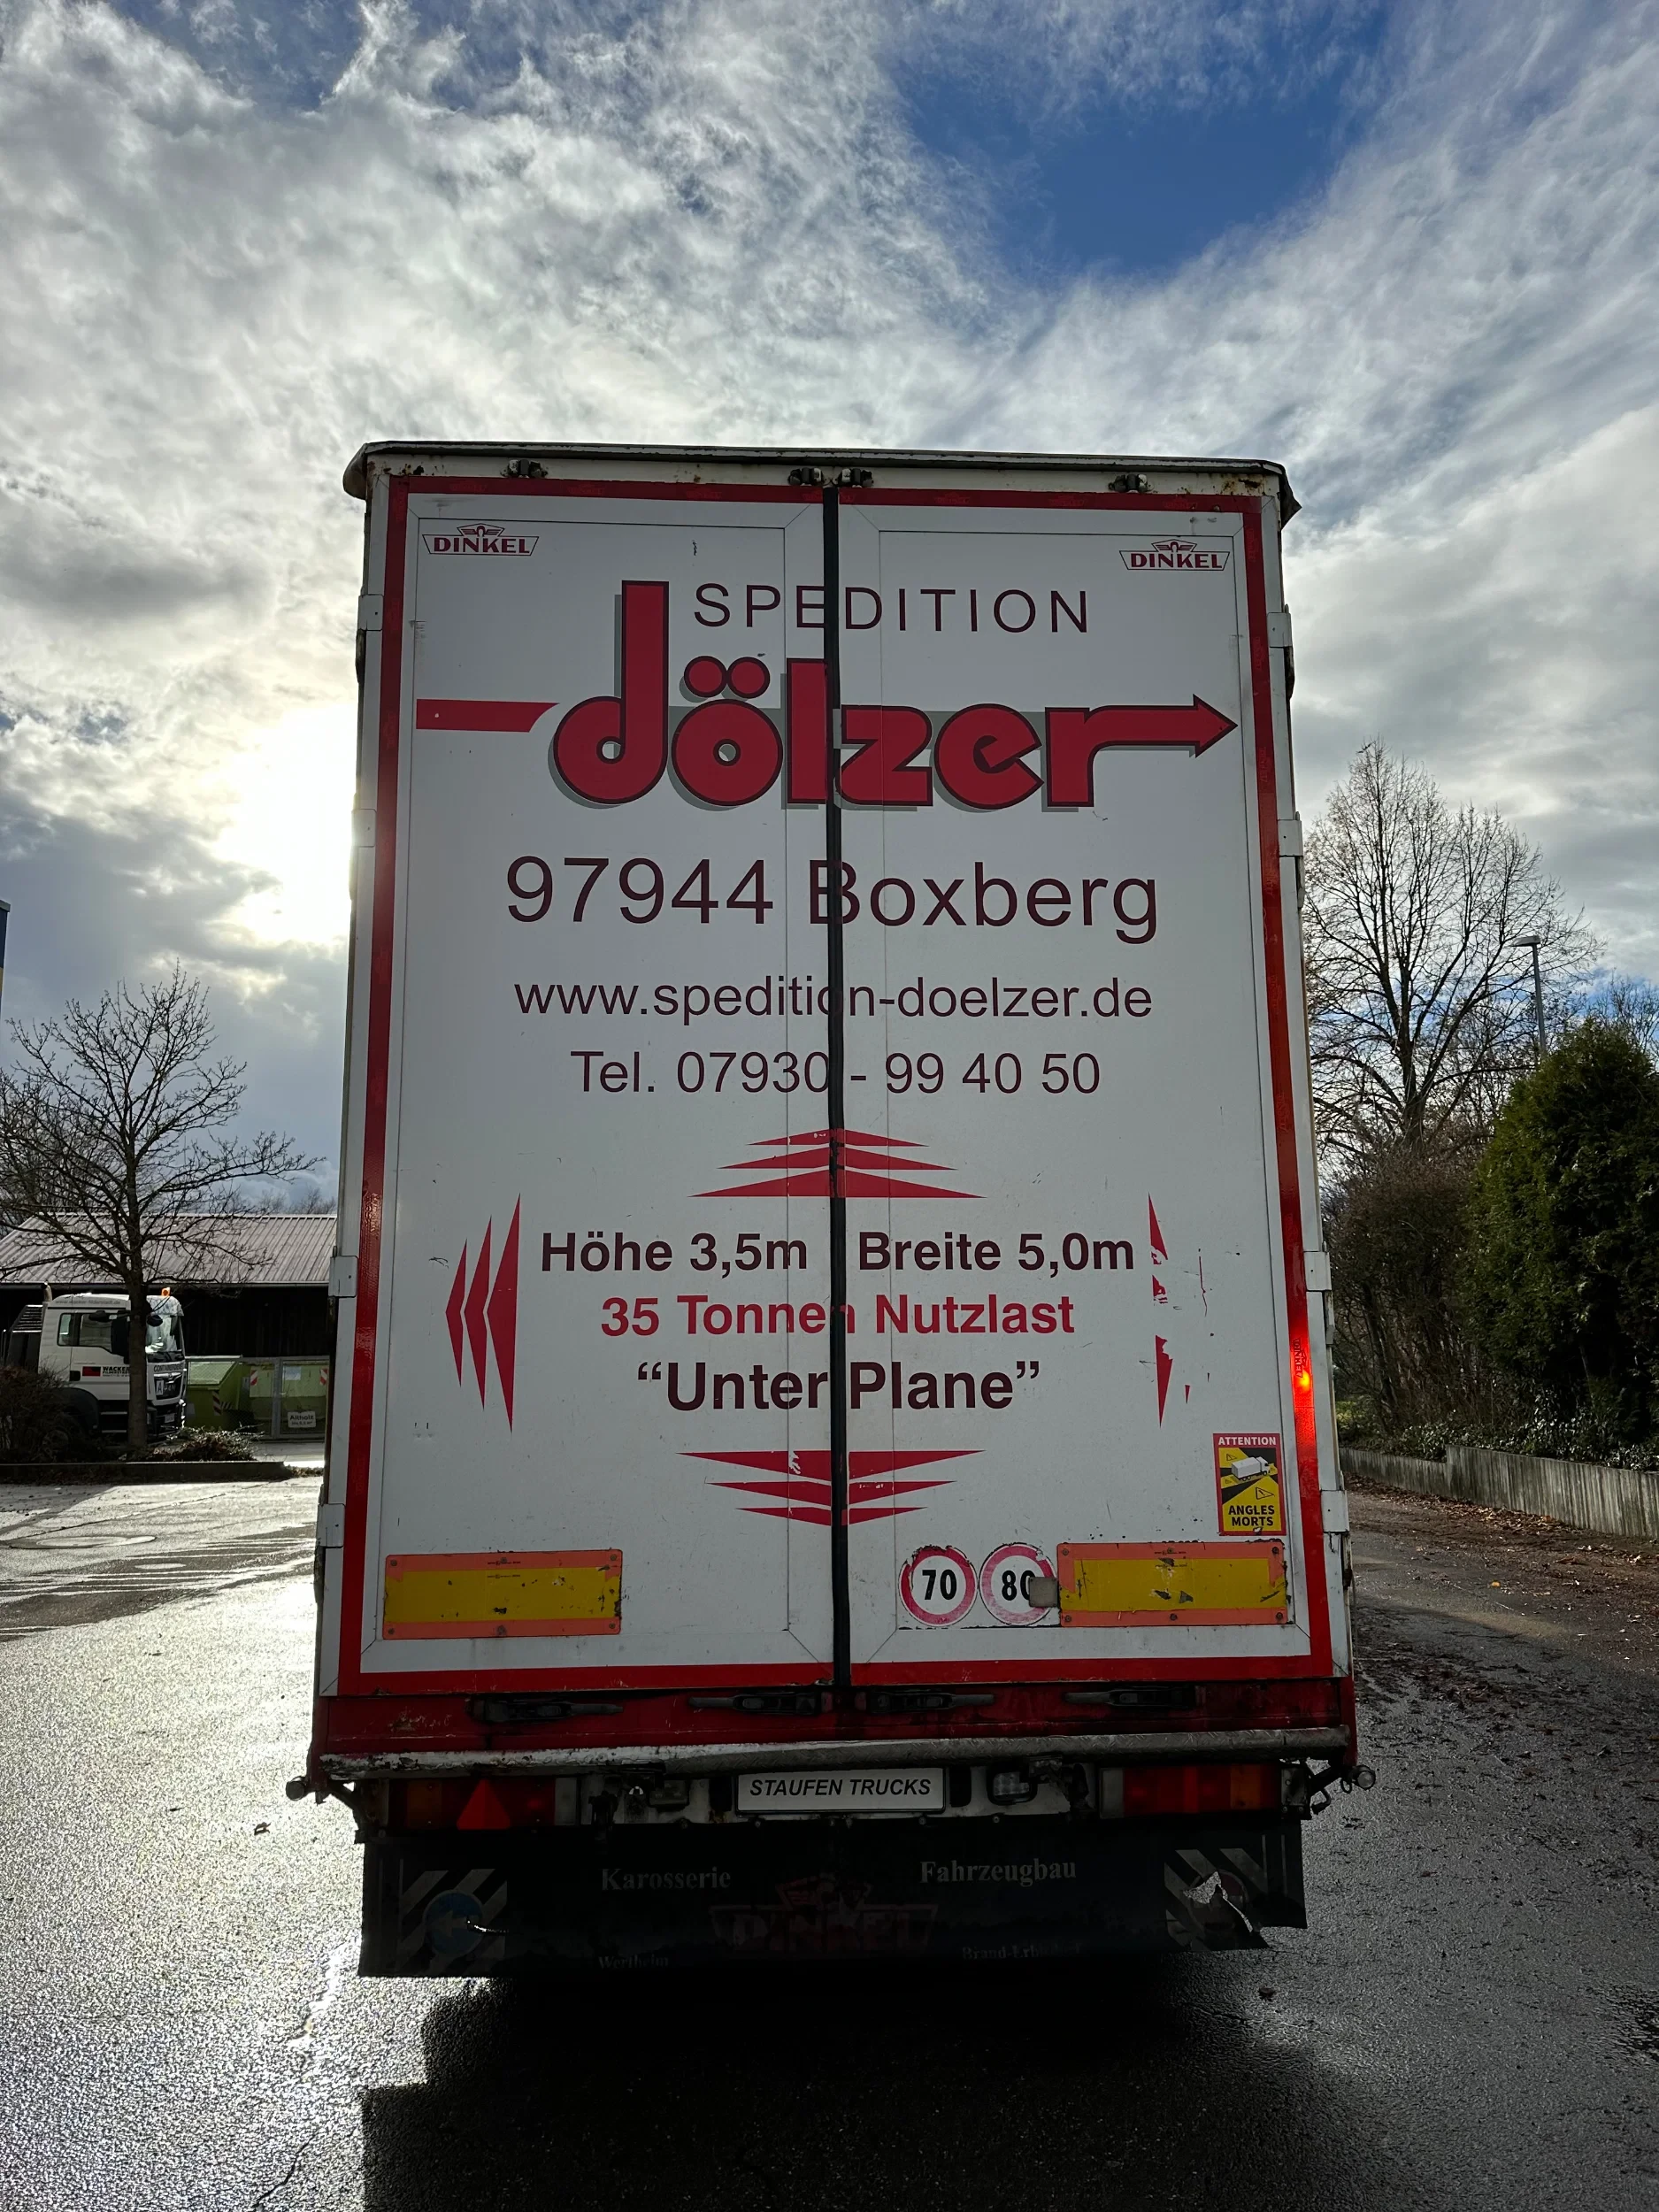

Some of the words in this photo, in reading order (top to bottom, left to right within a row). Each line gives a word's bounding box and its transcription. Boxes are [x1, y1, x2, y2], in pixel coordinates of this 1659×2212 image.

[434, 537, 531, 555] DINKEL
[1130, 552, 1223, 570] DINKEL
[694, 583, 1087, 634] SPEDITION
[549, 580, 1237, 810] dölzer
[507, 856, 773, 925] 97944
[809, 859, 1157, 944] Boxberg
[513, 975, 1152, 1025] www.spedition-doelzer.de
[570, 1050, 655, 1094] Tel.
[677, 1051, 829, 1094] 07930
[885, 1052, 944, 1094] 99
[962, 1052, 1022, 1094] 40
[1041, 1052, 1100, 1094] 50
[541, 1231, 672, 1272] Höhe
[689, 1233, 807, 1279] 3,5m
[859, 1231, 1002, 1271] Breite
[1018, 1232, 1134, 1279] 5,0m
[601, 1296, 659, 1337] 35
[876, 1294, 1075, 1334] Nutzlast
[1217, 1436, 1277, 1446] ATTENTION
[1228, 1505, 1275, 1516] ANGLES
[1231, 1516, 1274, 1527] MORTS
[922, 1569, 957, 1601] 70
[749, 1778, 843, 1797] STAUFEN
[849, 1778, 932, 1797] TRUCKS
[601, 1864, 732, 1892] Karosserie
[919, 1857, 1077, 1887] Fahrzeugbau
